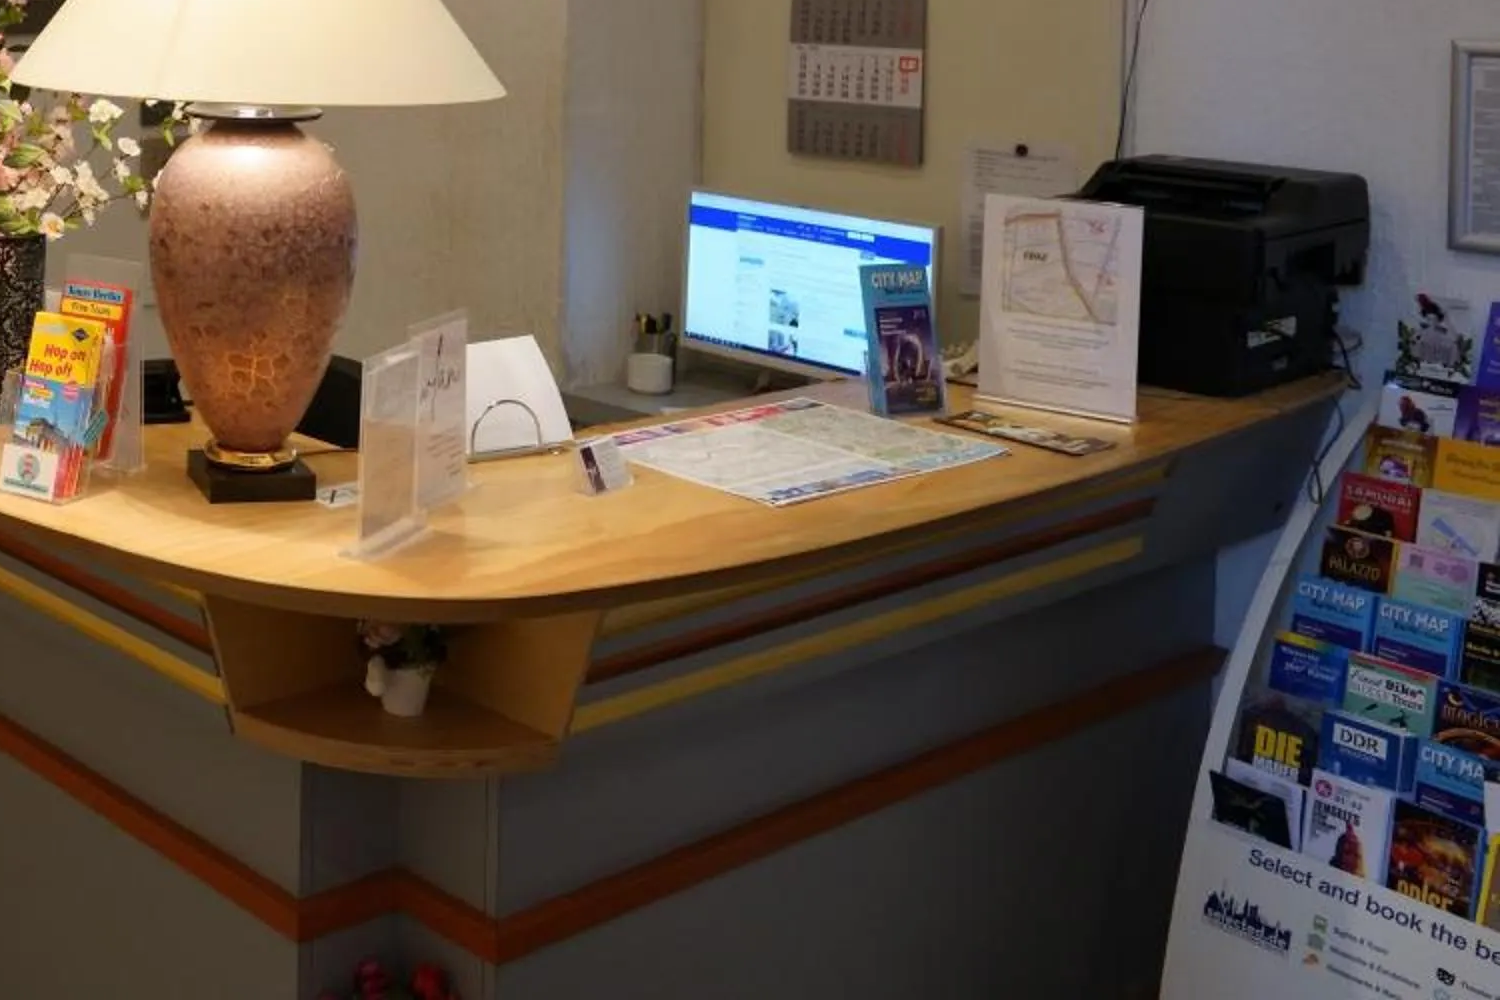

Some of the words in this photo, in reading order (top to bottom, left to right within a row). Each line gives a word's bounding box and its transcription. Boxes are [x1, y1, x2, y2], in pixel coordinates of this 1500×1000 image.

[872, 270, 896, 289] CITY
[897, 269, 924, 287] MAP
[29, 358, 53, 377] Hop
[44, 343, 68, 362] Hop
[1298, 581, 1329, 602] CITY
[1332, 590, 1366, 611] MAP
[1380, 602, 1412, 622] CITY
[1415, 612, 1449, 633] MAP
[1254, 724, 1303, 769] DIE
[1340, 728, 1379, 754] DDR
[1420, 746, 1453, 770] CITY
[1458, 758, 1484, 779] MA
[1248, 847, 1314, 889] Select
[1318, 879, 1361, 907] and
[1366, 895, 1424, 934] book
[1430, 921, 1468, 951] the
